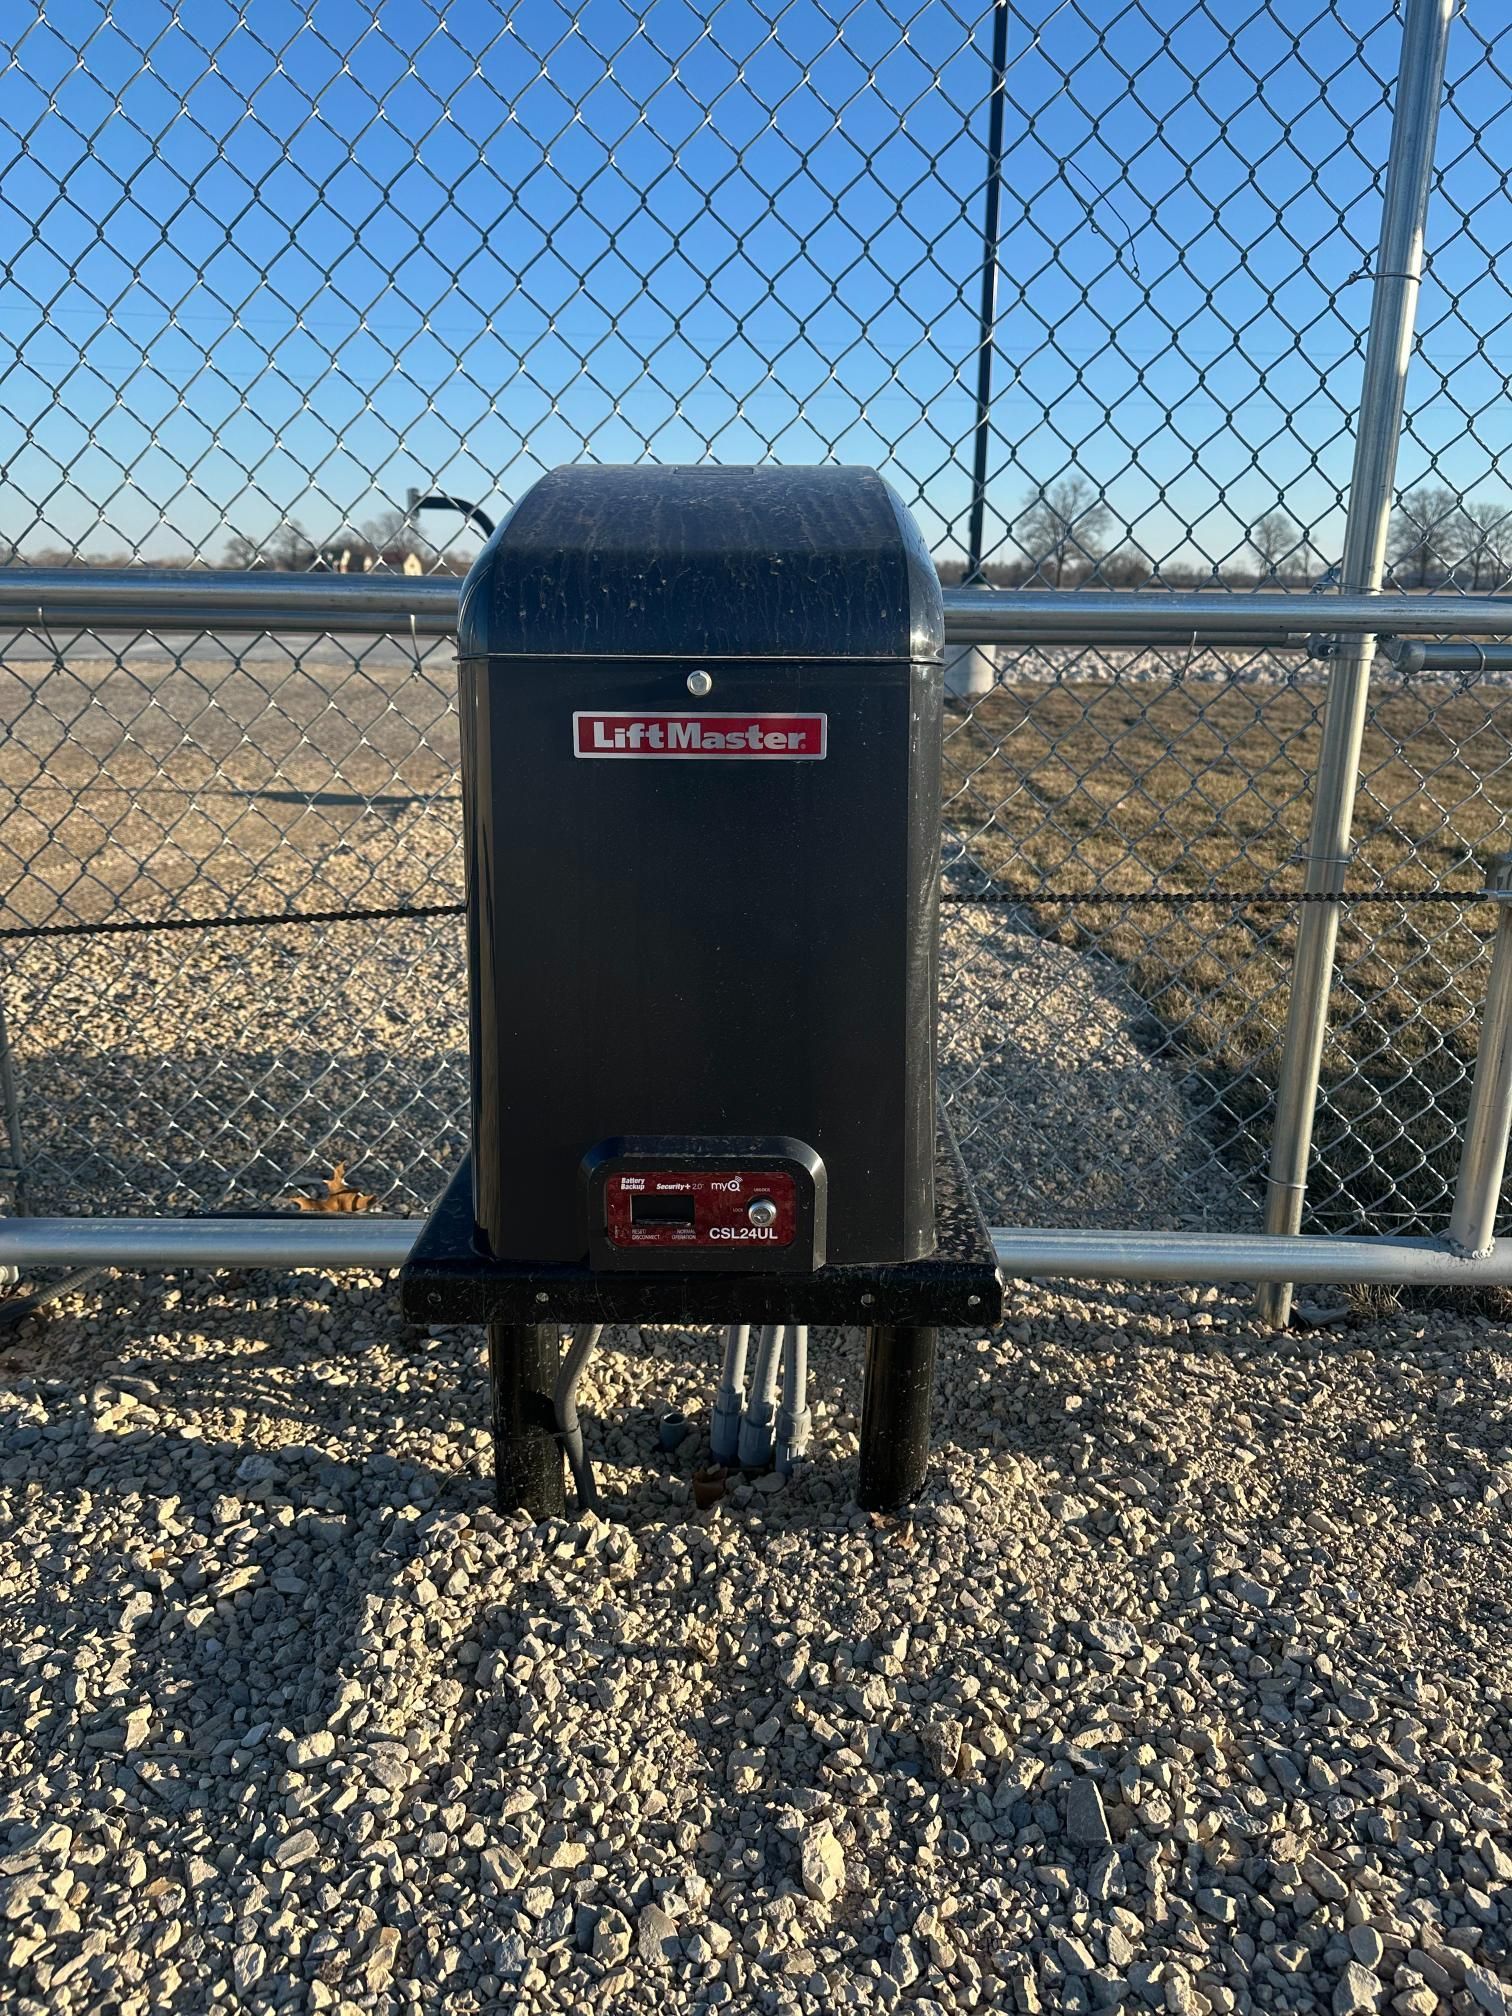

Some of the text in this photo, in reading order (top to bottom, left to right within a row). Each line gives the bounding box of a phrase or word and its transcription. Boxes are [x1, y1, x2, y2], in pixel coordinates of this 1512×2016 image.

[593, 721, 806, 750] LiftMaster
[621, 1177, 645, 1185] Battery
[620, 1183, 645, 1191] Backup
[656, 1183, 691, 1191] Security+
[709, 1227, 778, 1240] CSL24UL
